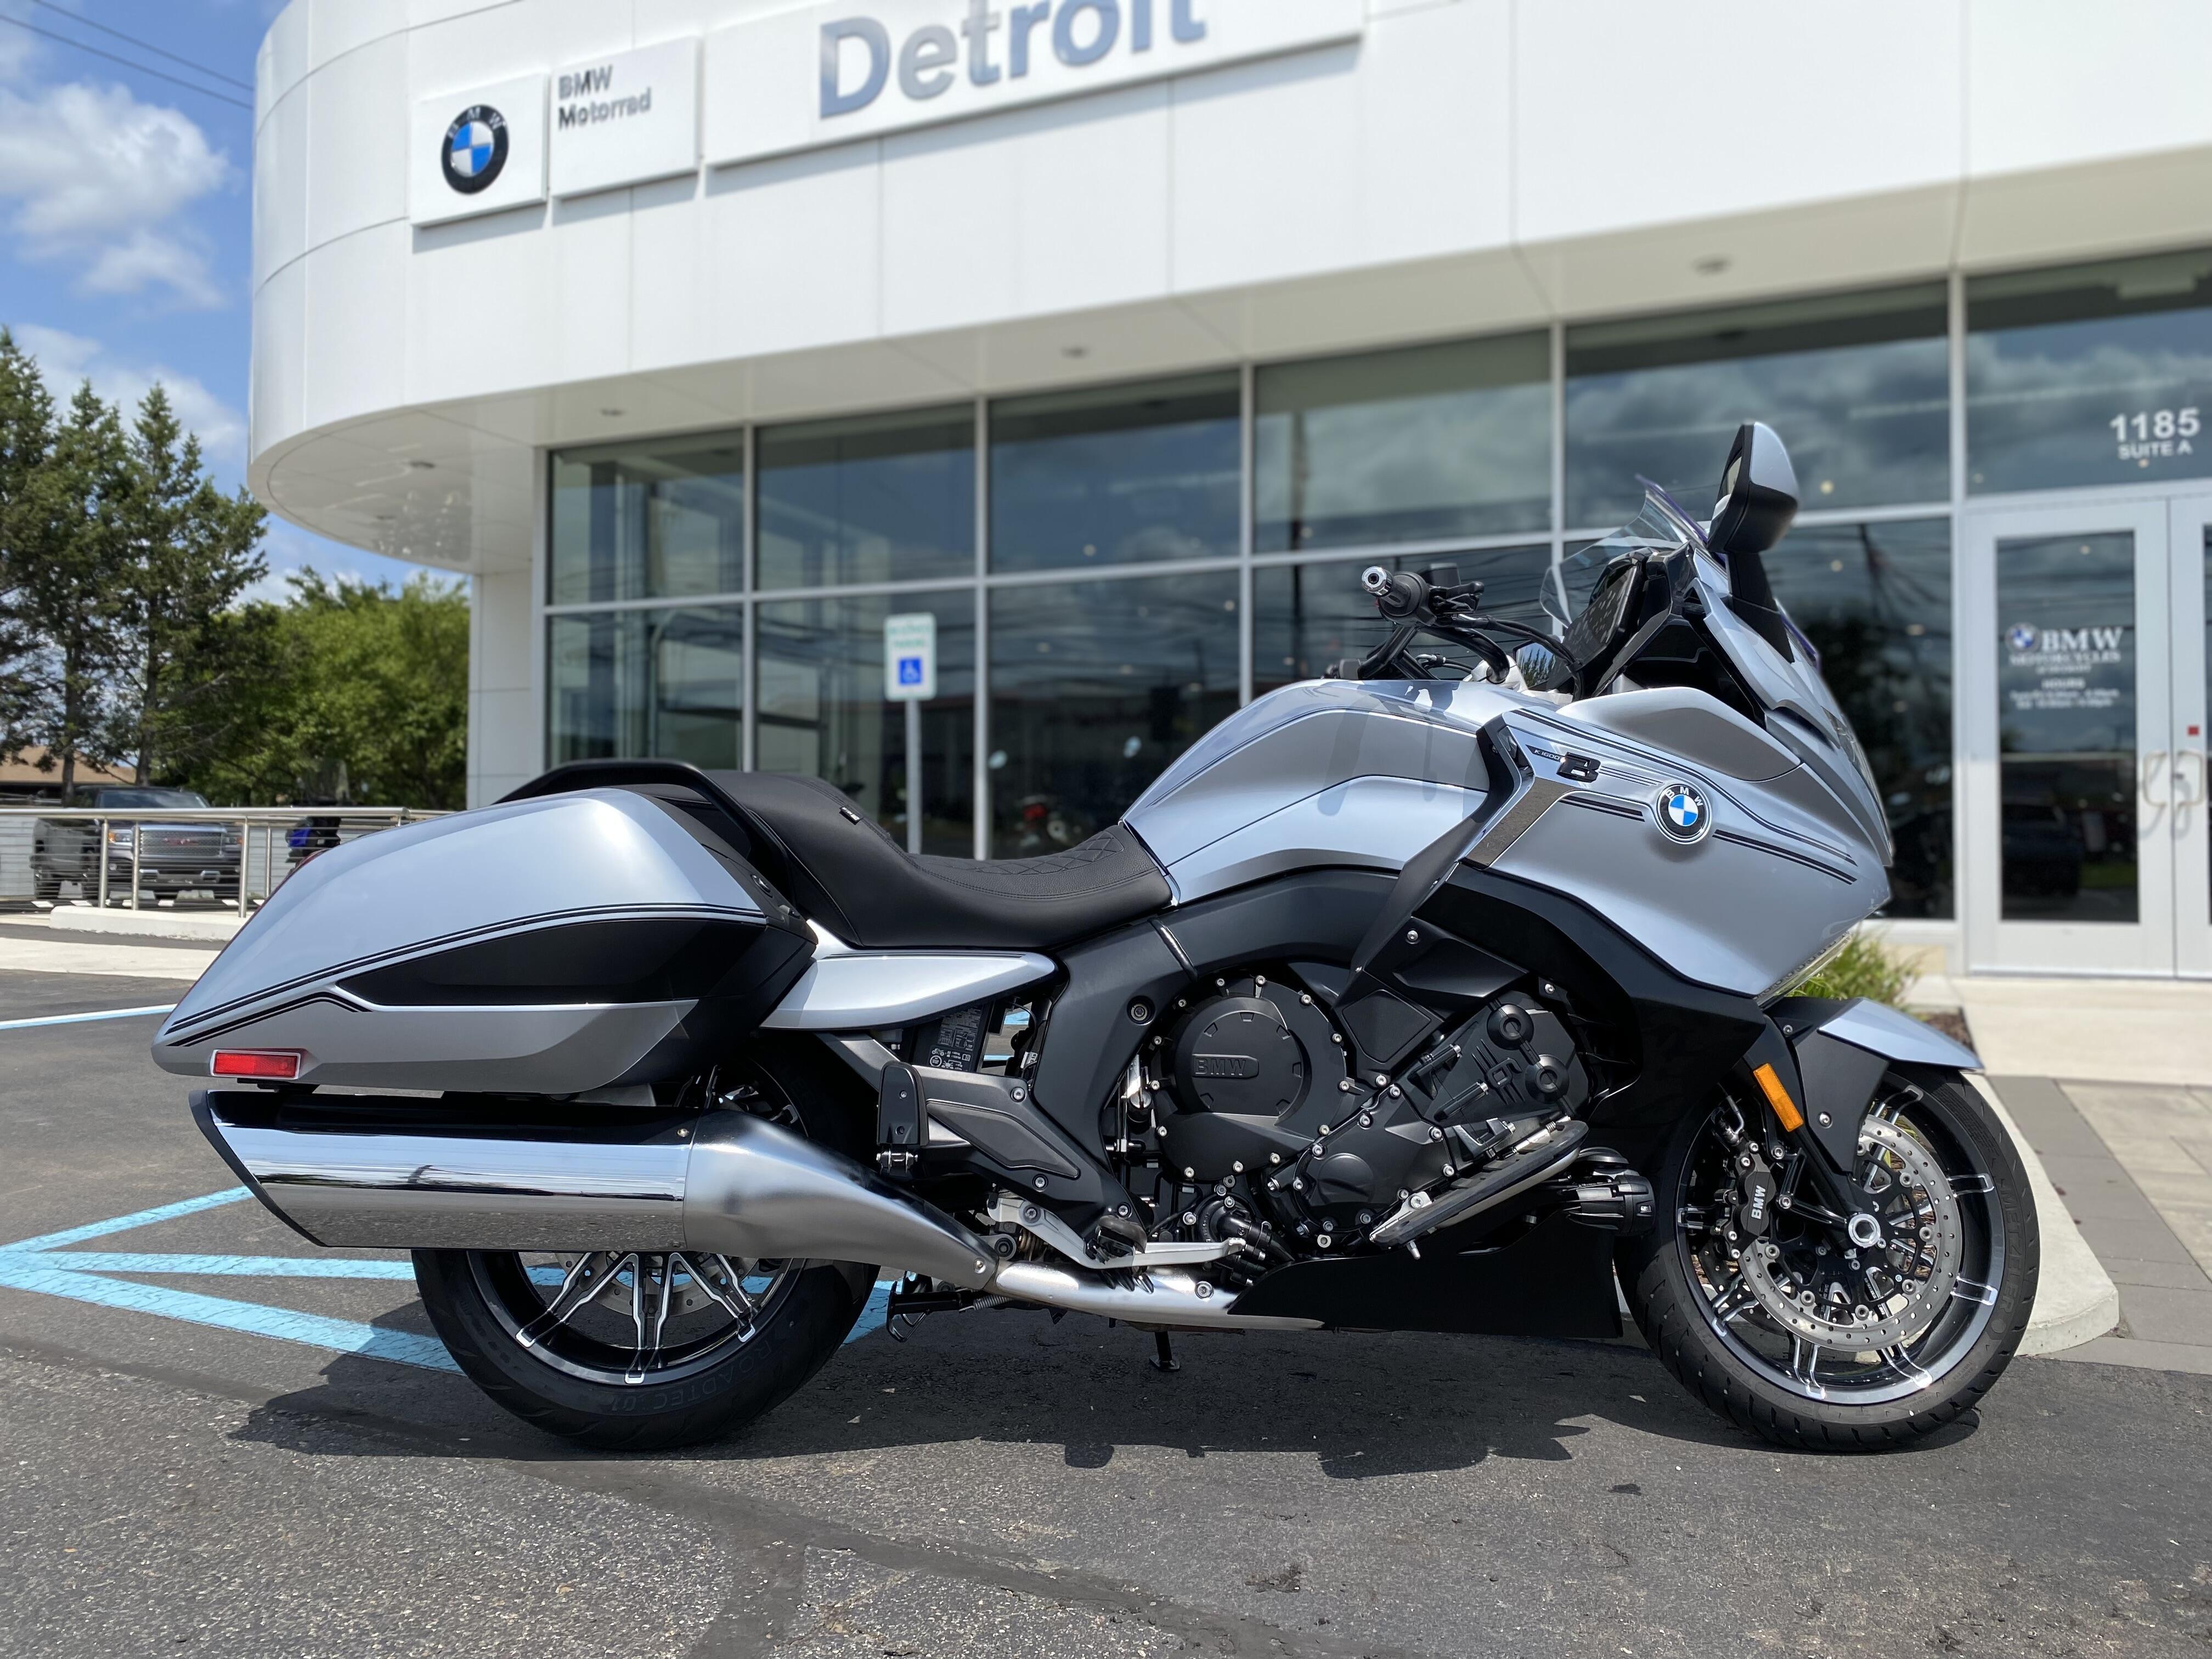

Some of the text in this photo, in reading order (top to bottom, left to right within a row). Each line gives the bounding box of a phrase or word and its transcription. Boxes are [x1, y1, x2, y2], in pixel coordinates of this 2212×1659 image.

[558, 64, 613, 100] BMW
[448, 106, 505, 139] BMW
[558, 87, 651, 131] Motorrad
[2109, 407, 2200, 443] 1185
[2118, 439, 2193, 460] SUITE A
[2042, 628, 2123, 651] BMW
[1541, 751, 1560, 760] 1600
[1664, 786, 1703, 806] BMW
[1195, 1057, 1246, 1076] BMW
[1751, 1185, 1766, 1220] BMW
[1999, 1189, 2023, 1313] METZELER
[653, 1341, 772, 1410] ROADTEC
